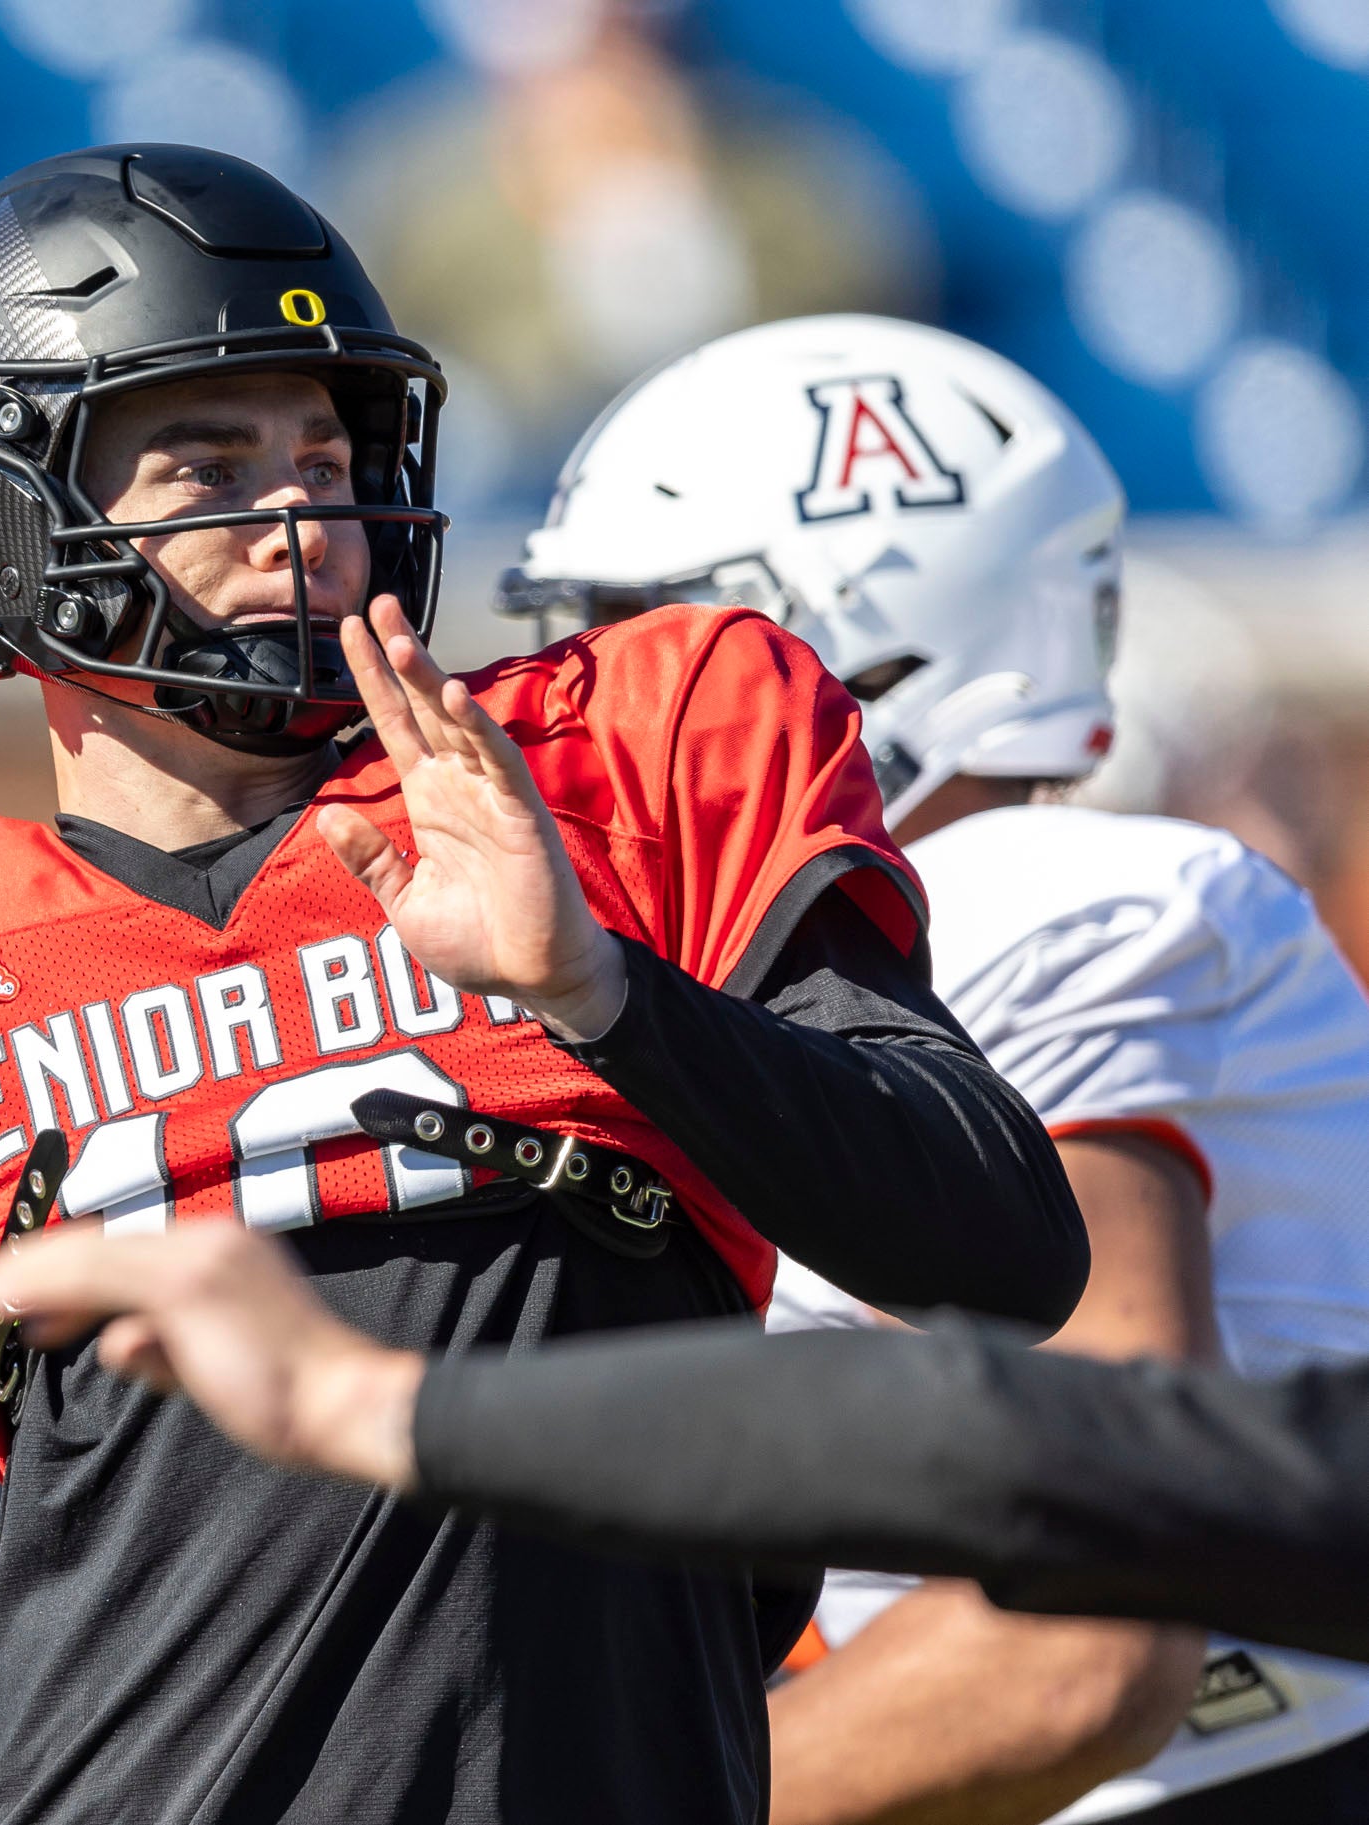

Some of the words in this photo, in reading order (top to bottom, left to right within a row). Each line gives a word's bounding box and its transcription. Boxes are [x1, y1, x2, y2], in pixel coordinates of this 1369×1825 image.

[279, 289, 326, 327] O
[794, 373, 966, 523] A
[297, 923, 536, 1053] BO
